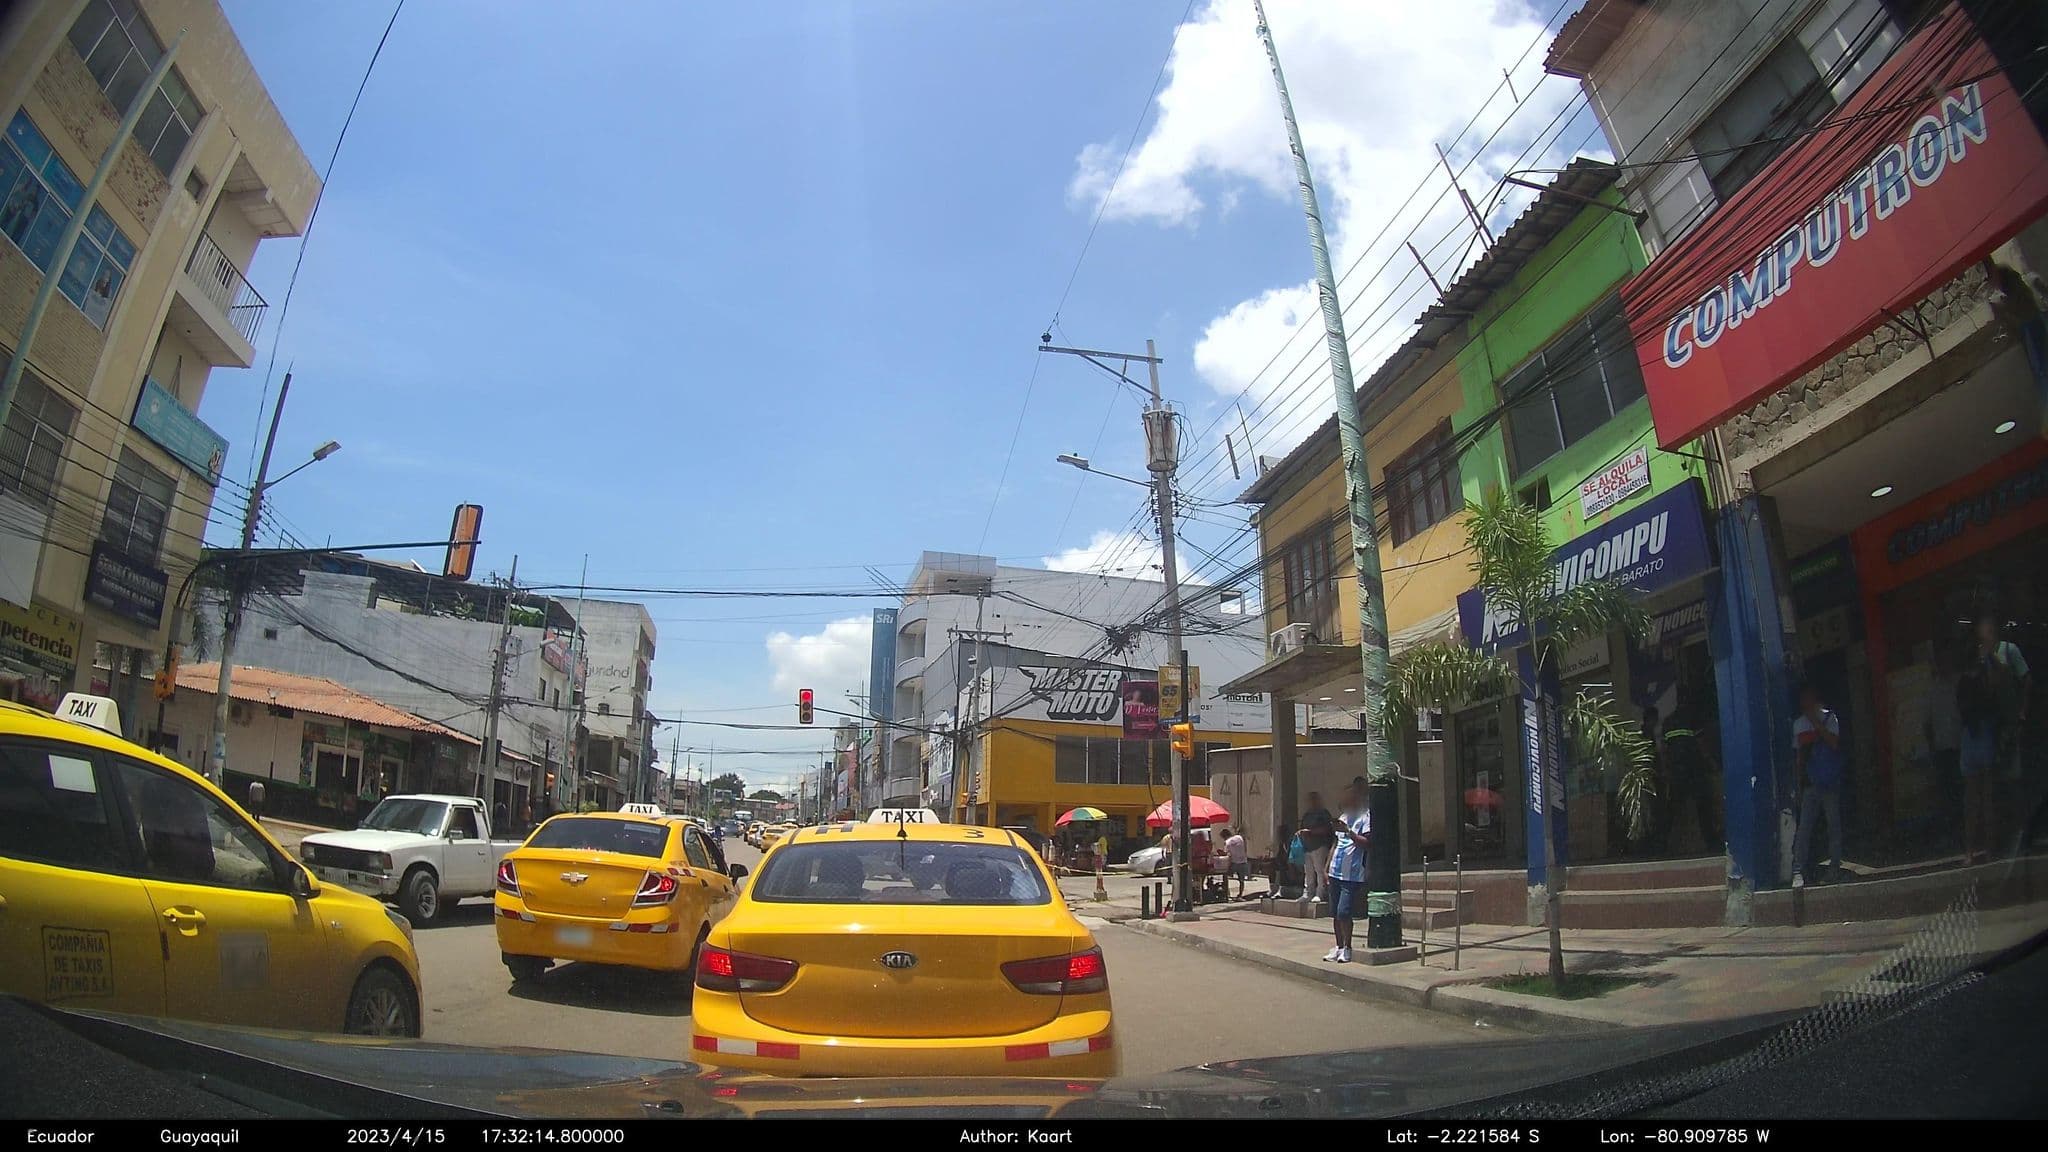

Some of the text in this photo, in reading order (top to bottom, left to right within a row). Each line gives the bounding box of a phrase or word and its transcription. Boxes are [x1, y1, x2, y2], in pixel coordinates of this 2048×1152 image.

[1663, 82, 1987, 368] COMPUTRON
[1583, 454, 1643, 496] SE ALQUILA
[1597, 474, 1632, 499] LOCAL
[1538, 511, 1669, 600] VICOMPU
[1620, 557, 1664, 586] BARATO
[1030, 667, 1123, 691] MASTER
[68, 699, 98, 718] TAXI
[1047, 691, 1115, 716] MOTO
[628, 804, 653, 814] TAXI
[881, 810, 924, 824] TAXI
[48, 934, 105, 953] COMPAÑIA
[54, 956, 104, 974] DE TAXIS
[885, 954, 913, 967] KIA
